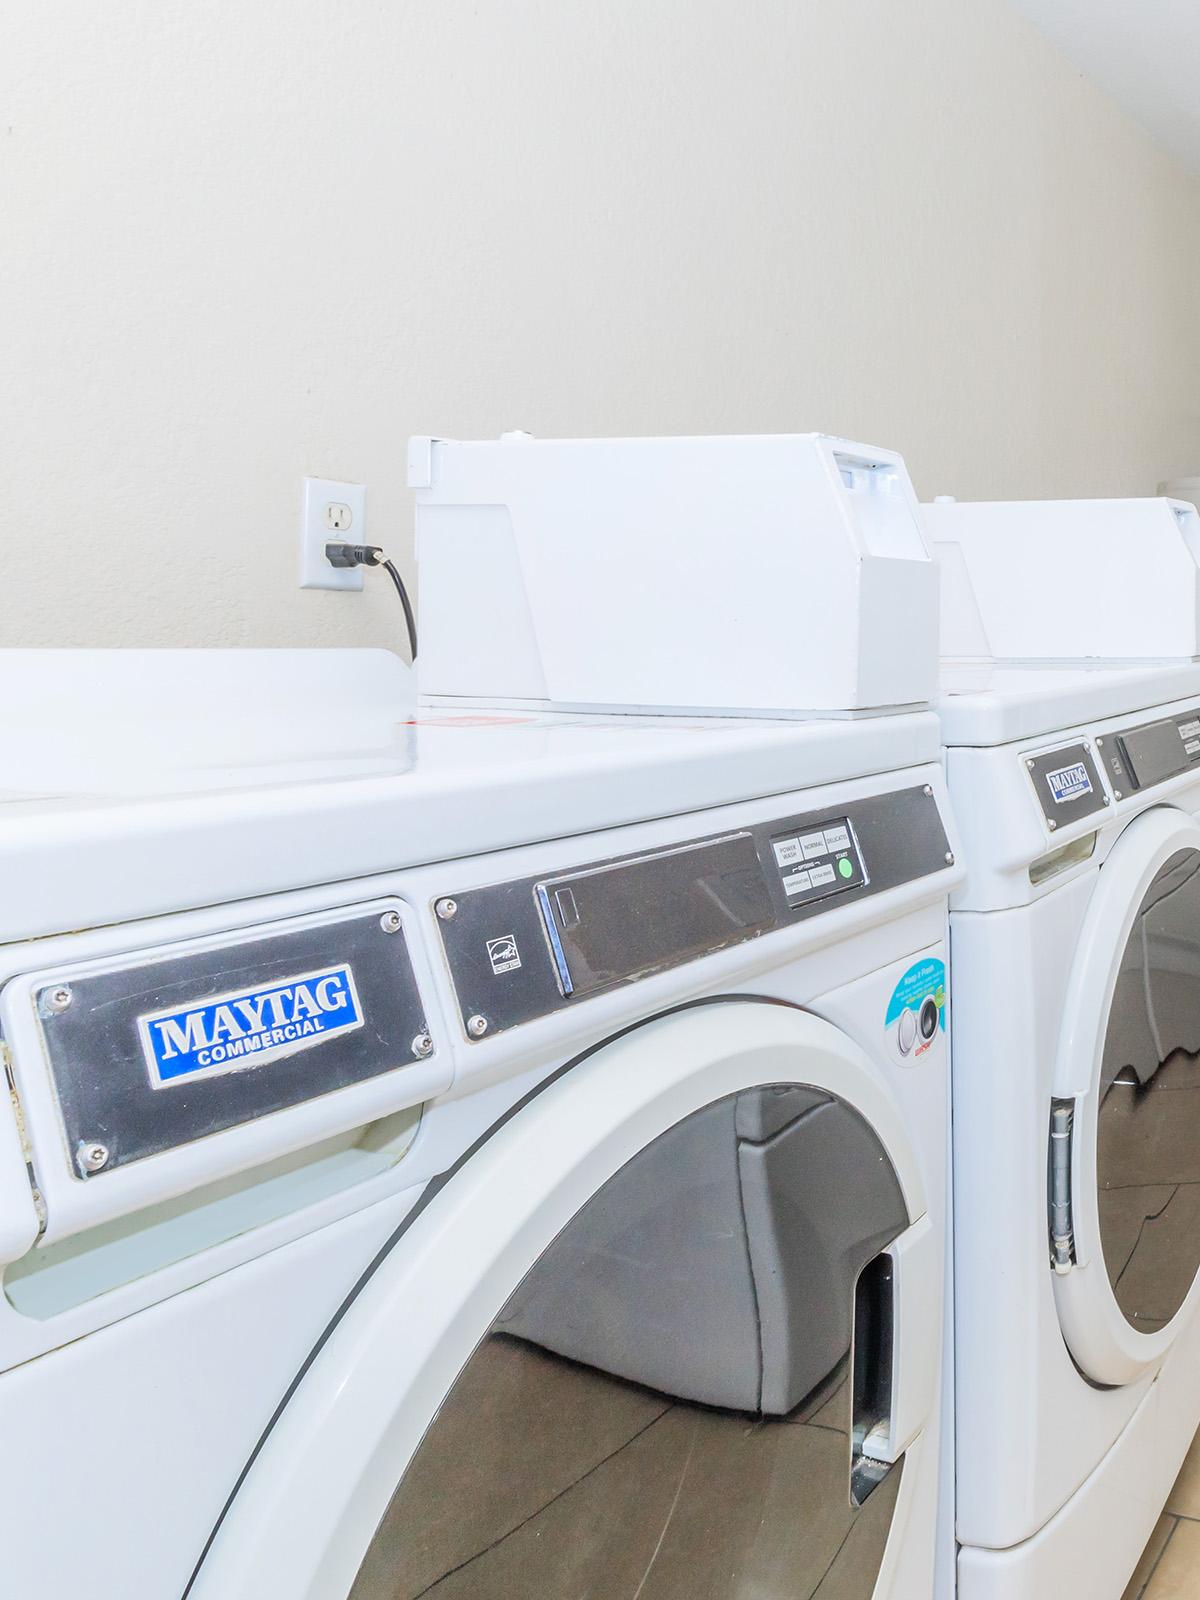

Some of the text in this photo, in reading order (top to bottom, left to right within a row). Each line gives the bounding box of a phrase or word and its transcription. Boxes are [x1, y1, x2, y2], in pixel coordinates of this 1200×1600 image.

[1050, 767, 1087, 792] MAYTAG
[779, 844, 797, 854] POWER
[804, 841, 824, 851] NORMAL
[783, 852, 797, 860] WASH
[835, 851, 848, 860] START
[154, 976, 348, 1061] MAYTAG
[197, 1017, 325, 1067] COMMERCIAL
